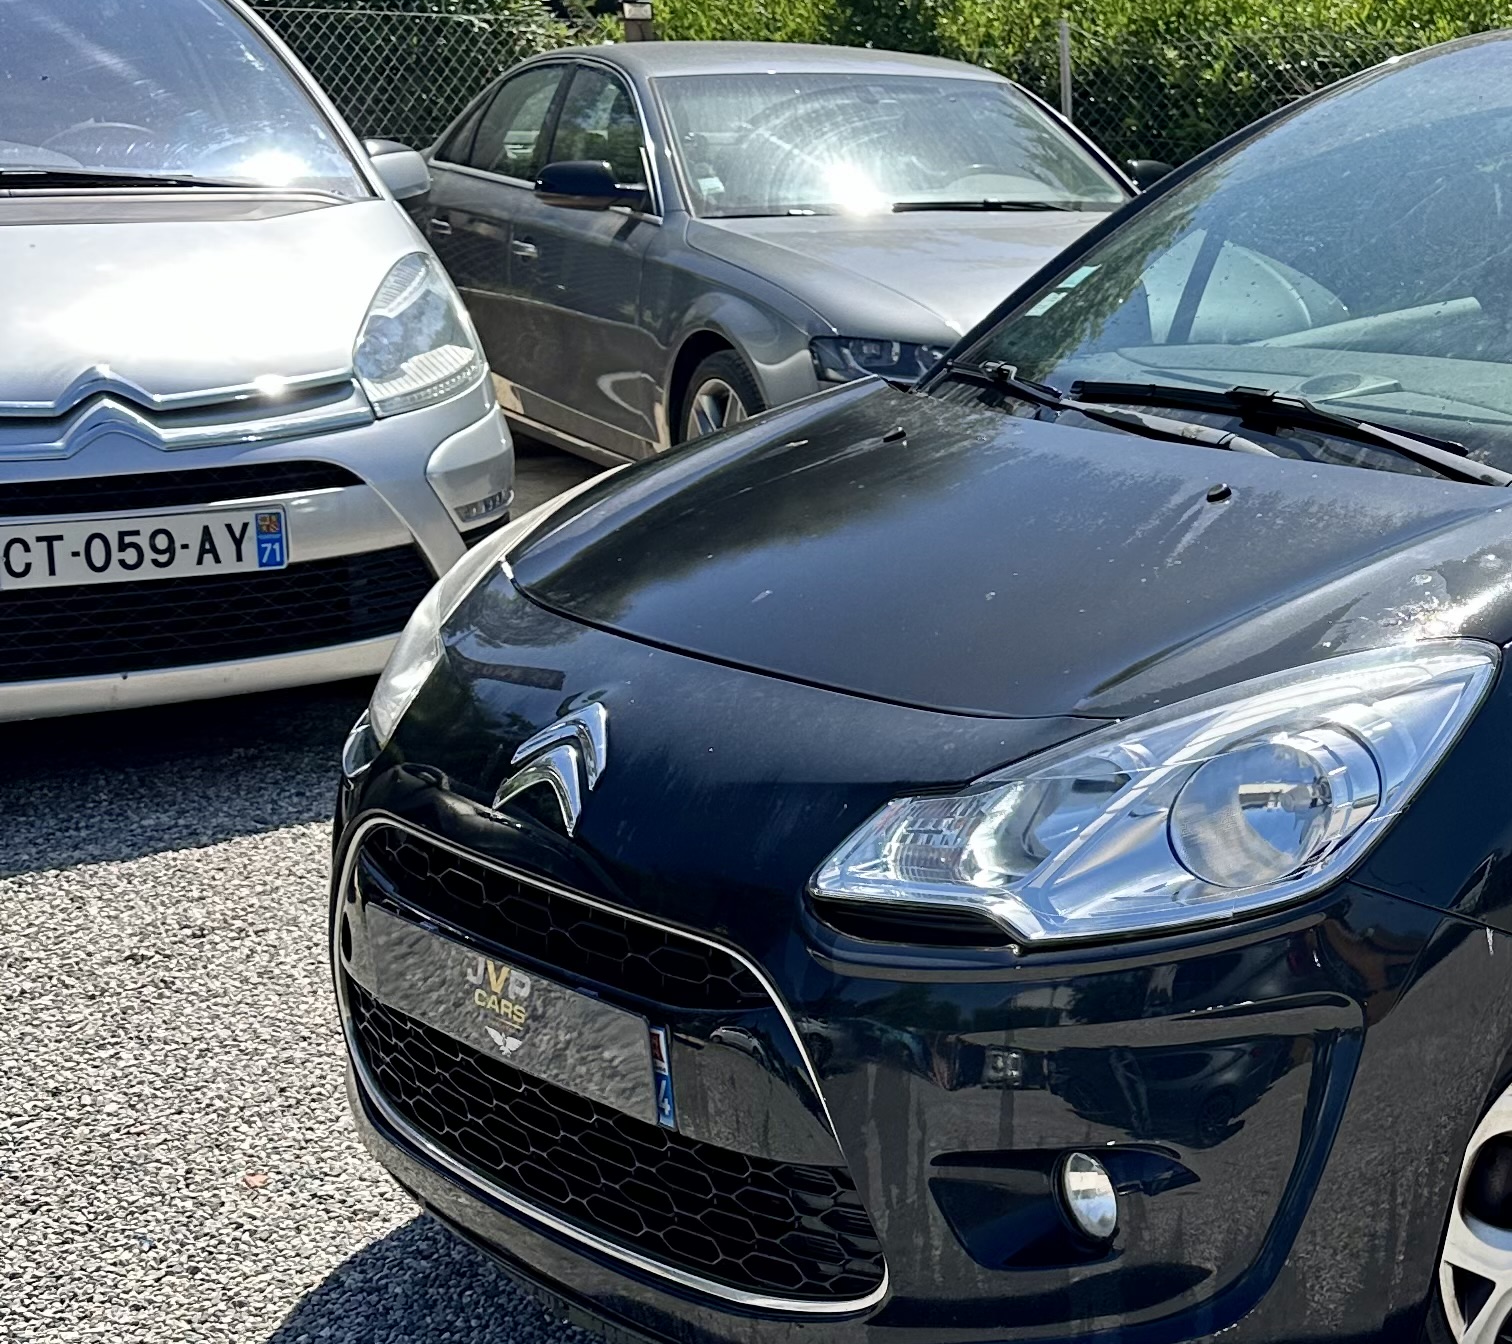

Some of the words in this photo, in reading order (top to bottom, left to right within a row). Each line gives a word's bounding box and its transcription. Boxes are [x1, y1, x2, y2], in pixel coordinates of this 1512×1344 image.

[4, 522, 249, 578] CT-059-AY
[261, 542, 280, 563] 71
[475, 989, 525, 1023] CARS
